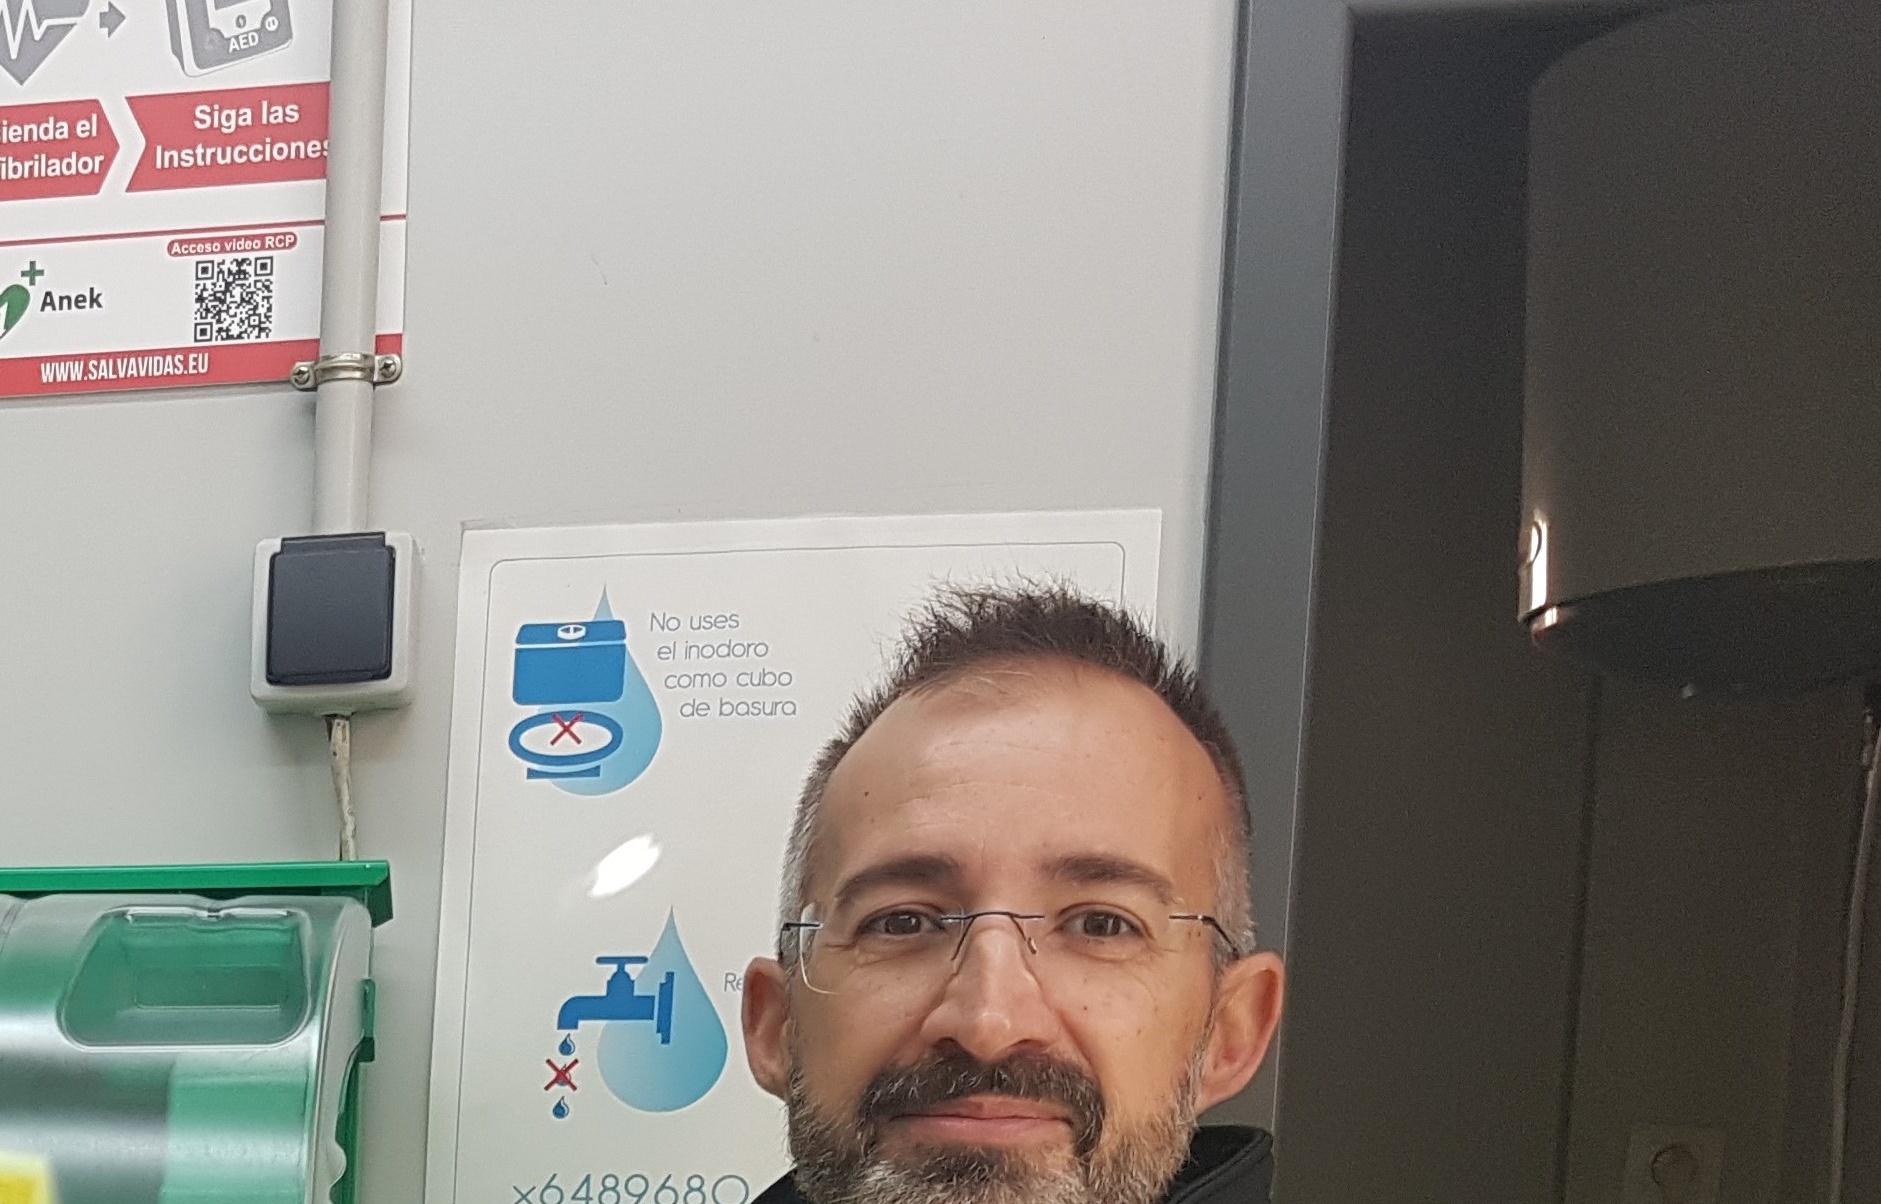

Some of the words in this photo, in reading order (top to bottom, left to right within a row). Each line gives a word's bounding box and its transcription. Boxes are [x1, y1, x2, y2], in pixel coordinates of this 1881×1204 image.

[228, 32, 259, 53] AED
[75, 113, 98, 139] el
[193, 102, 252, 135] Siga
[262, 100, 300, 125] las
[171, 240, 221, 255] Acceso
[224, 238, 261, 252] video
[264, 234, 296, 250] RCP
[40, 287, 103, 312] Anek
[40, 352, 209, 383] WWW.SALVAVIDAS.EU
[650, 612, 681, 632] No
[689, 613, 740, 631] uses
[657, 641, 676, 661] el
[684, 639, 769, 660] inodoro
[664, 672, 727, 689] como
[736, 668, 793, 687] cubo
[680, 699, 710, 717] de
[719, 698, 797, 717] basura
